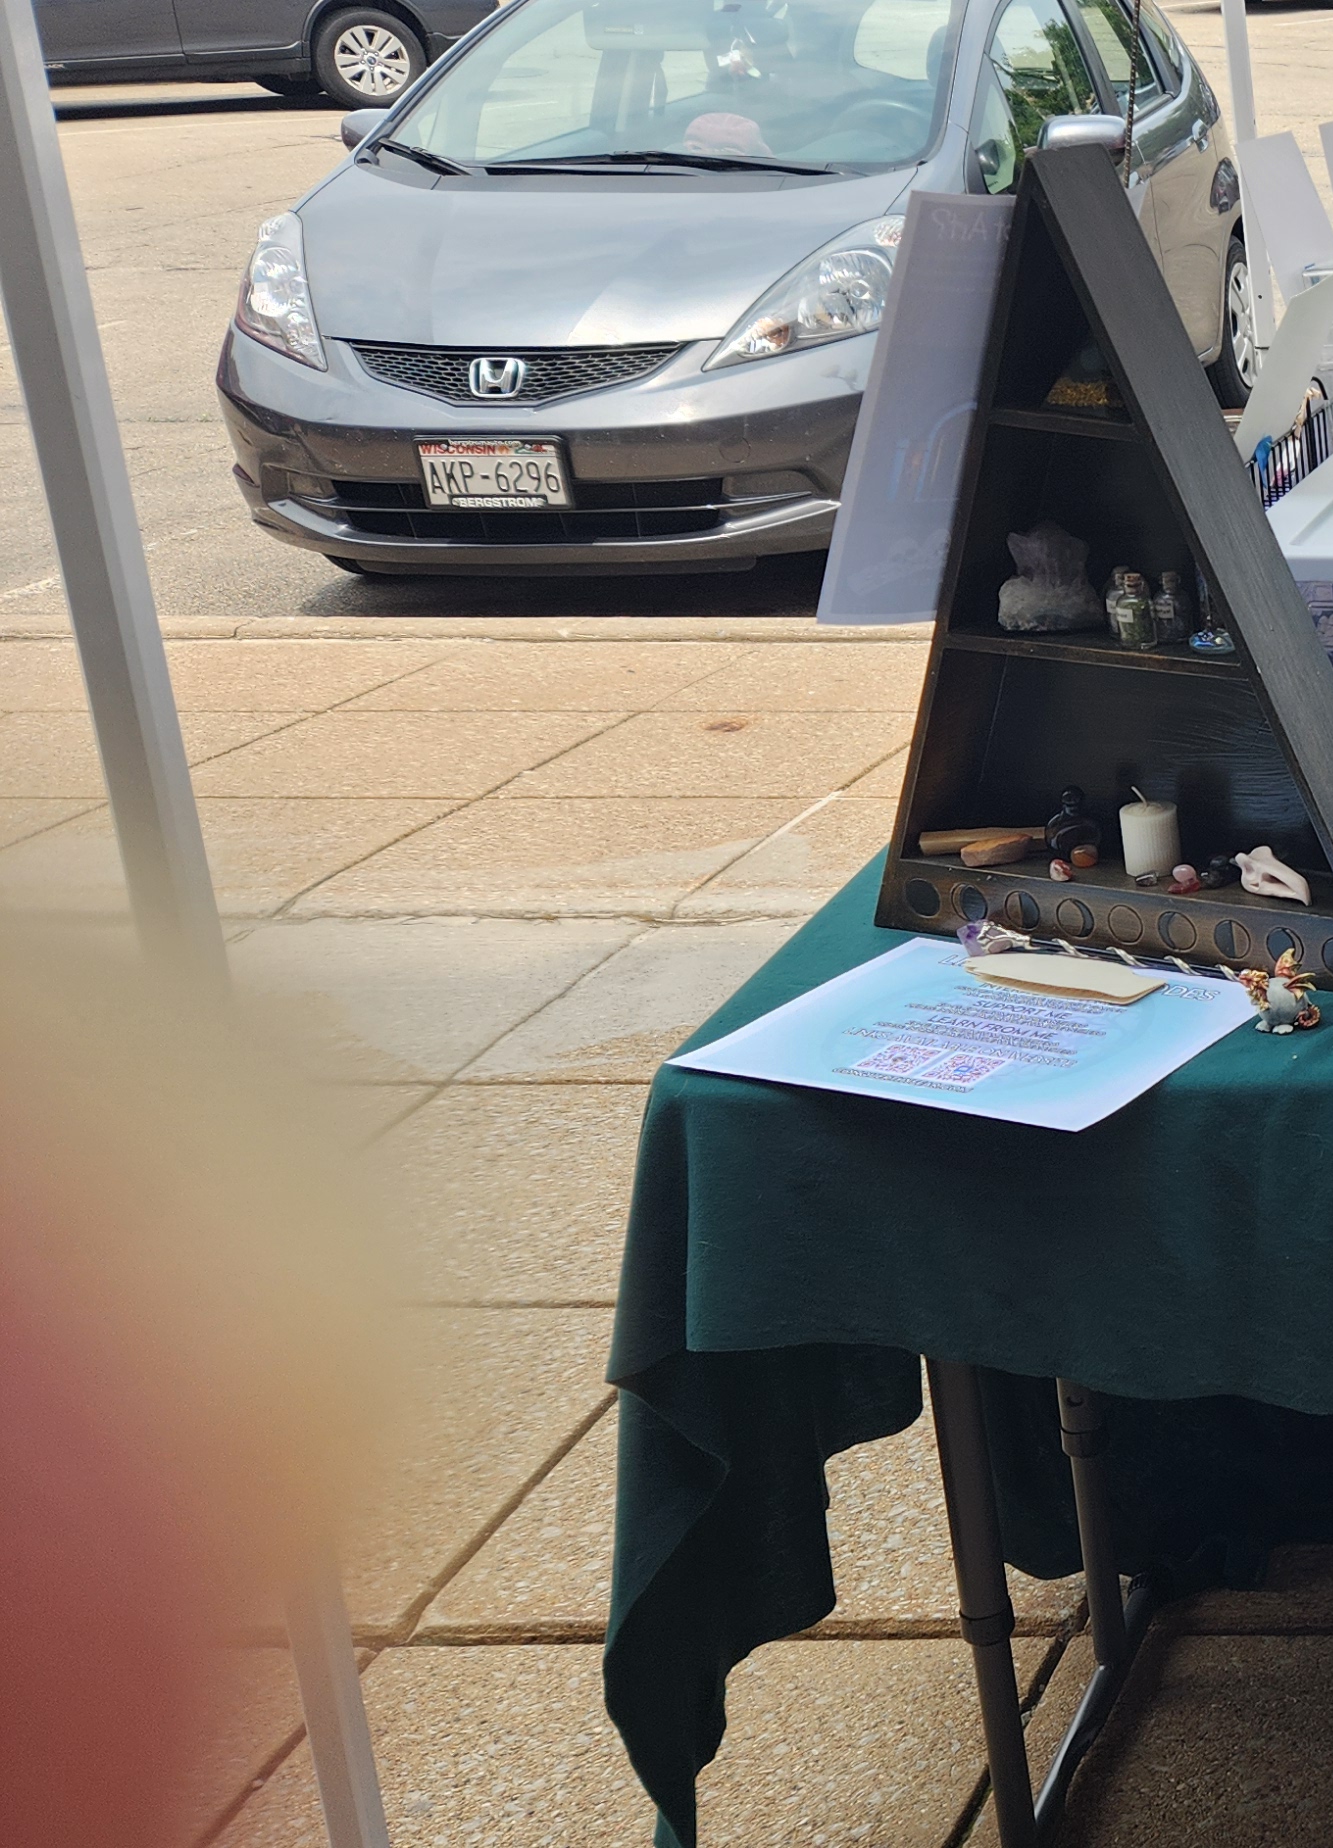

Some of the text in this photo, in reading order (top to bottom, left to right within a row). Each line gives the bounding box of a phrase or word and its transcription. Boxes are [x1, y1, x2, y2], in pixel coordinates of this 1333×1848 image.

[420, 444, 496, 455] WISCONSIN
[428, 459, 562, 495] AKP-6296
[459, 497, 539, 509] BERGSTROM
[973, 1000, 1073, 1020] SUPPORT ME
[927, 1014, 979, 1029] LEARN
[981, 1021, 1031, 1036] FROM
[1029, 1030, 1059, 1040] ME
